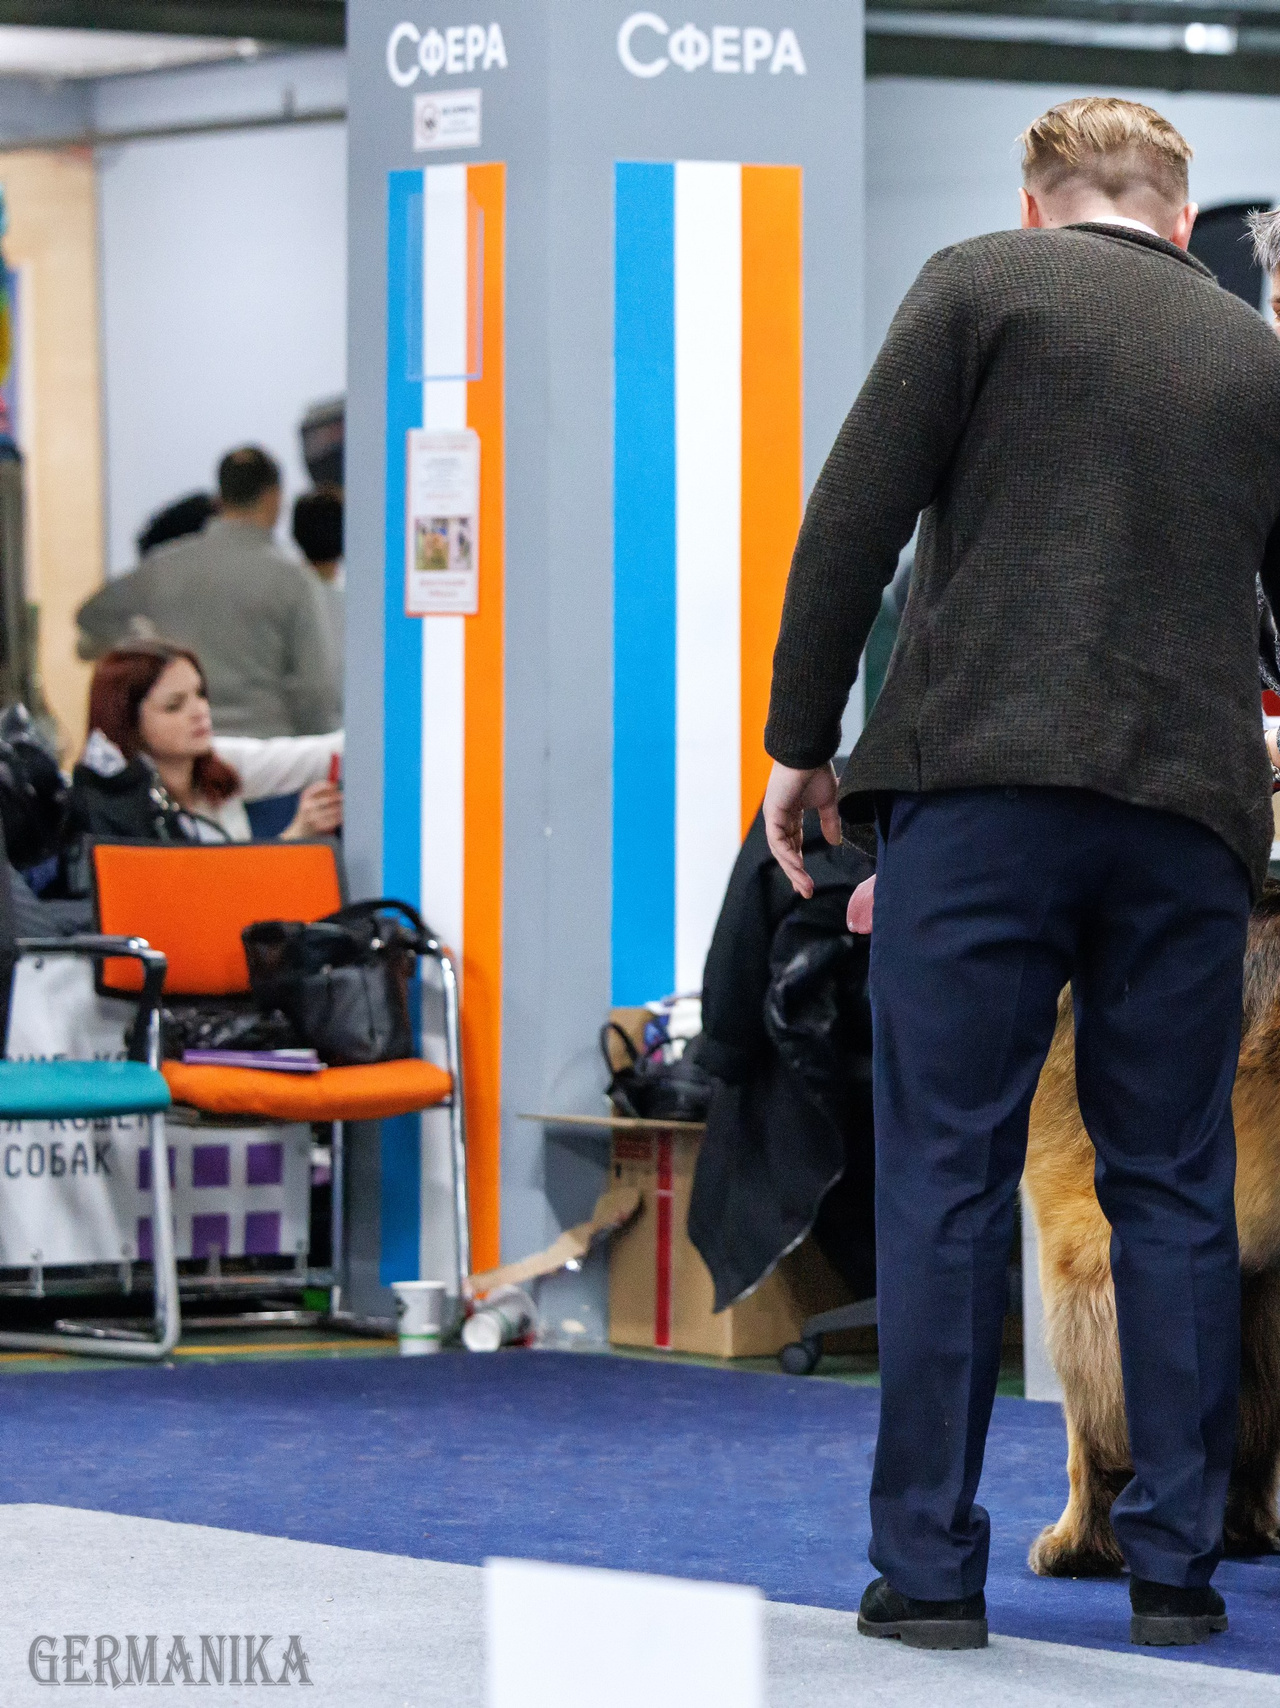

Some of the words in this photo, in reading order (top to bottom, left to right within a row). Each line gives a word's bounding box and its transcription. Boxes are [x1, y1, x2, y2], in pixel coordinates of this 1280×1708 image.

[387, 22, 507, 87] СФЕРА
[617, 12, 807, 78] СФЕРА
[5, 1142, 111, 1178] СОБАК
